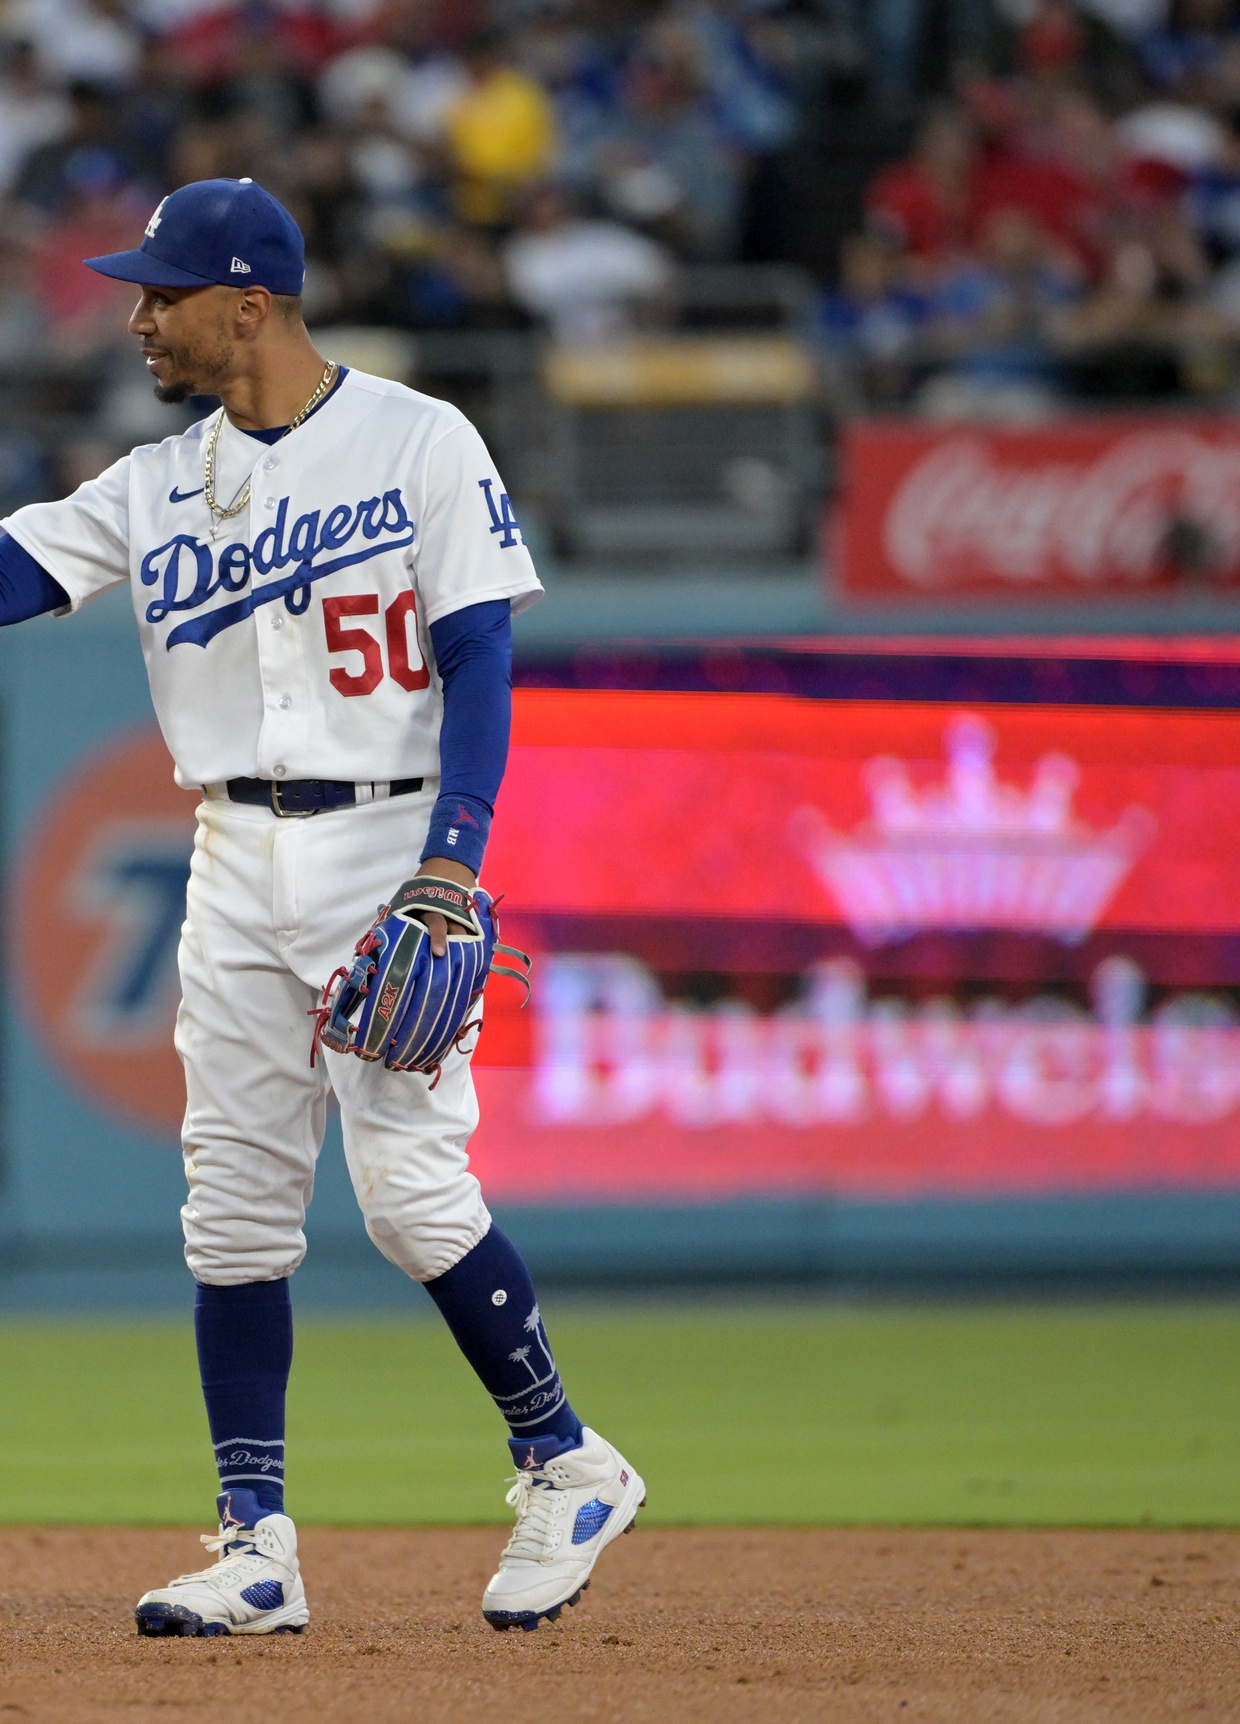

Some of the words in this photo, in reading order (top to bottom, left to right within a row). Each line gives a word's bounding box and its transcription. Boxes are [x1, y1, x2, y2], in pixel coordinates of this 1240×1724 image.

[478, 478, 525, 549] LA
[140, 487, 415, 626] Dodgers
[321, 589, 430, 698] 50
[404, 886, 462, 906] Wilson
[378, 982, 400, 1021] A2K
